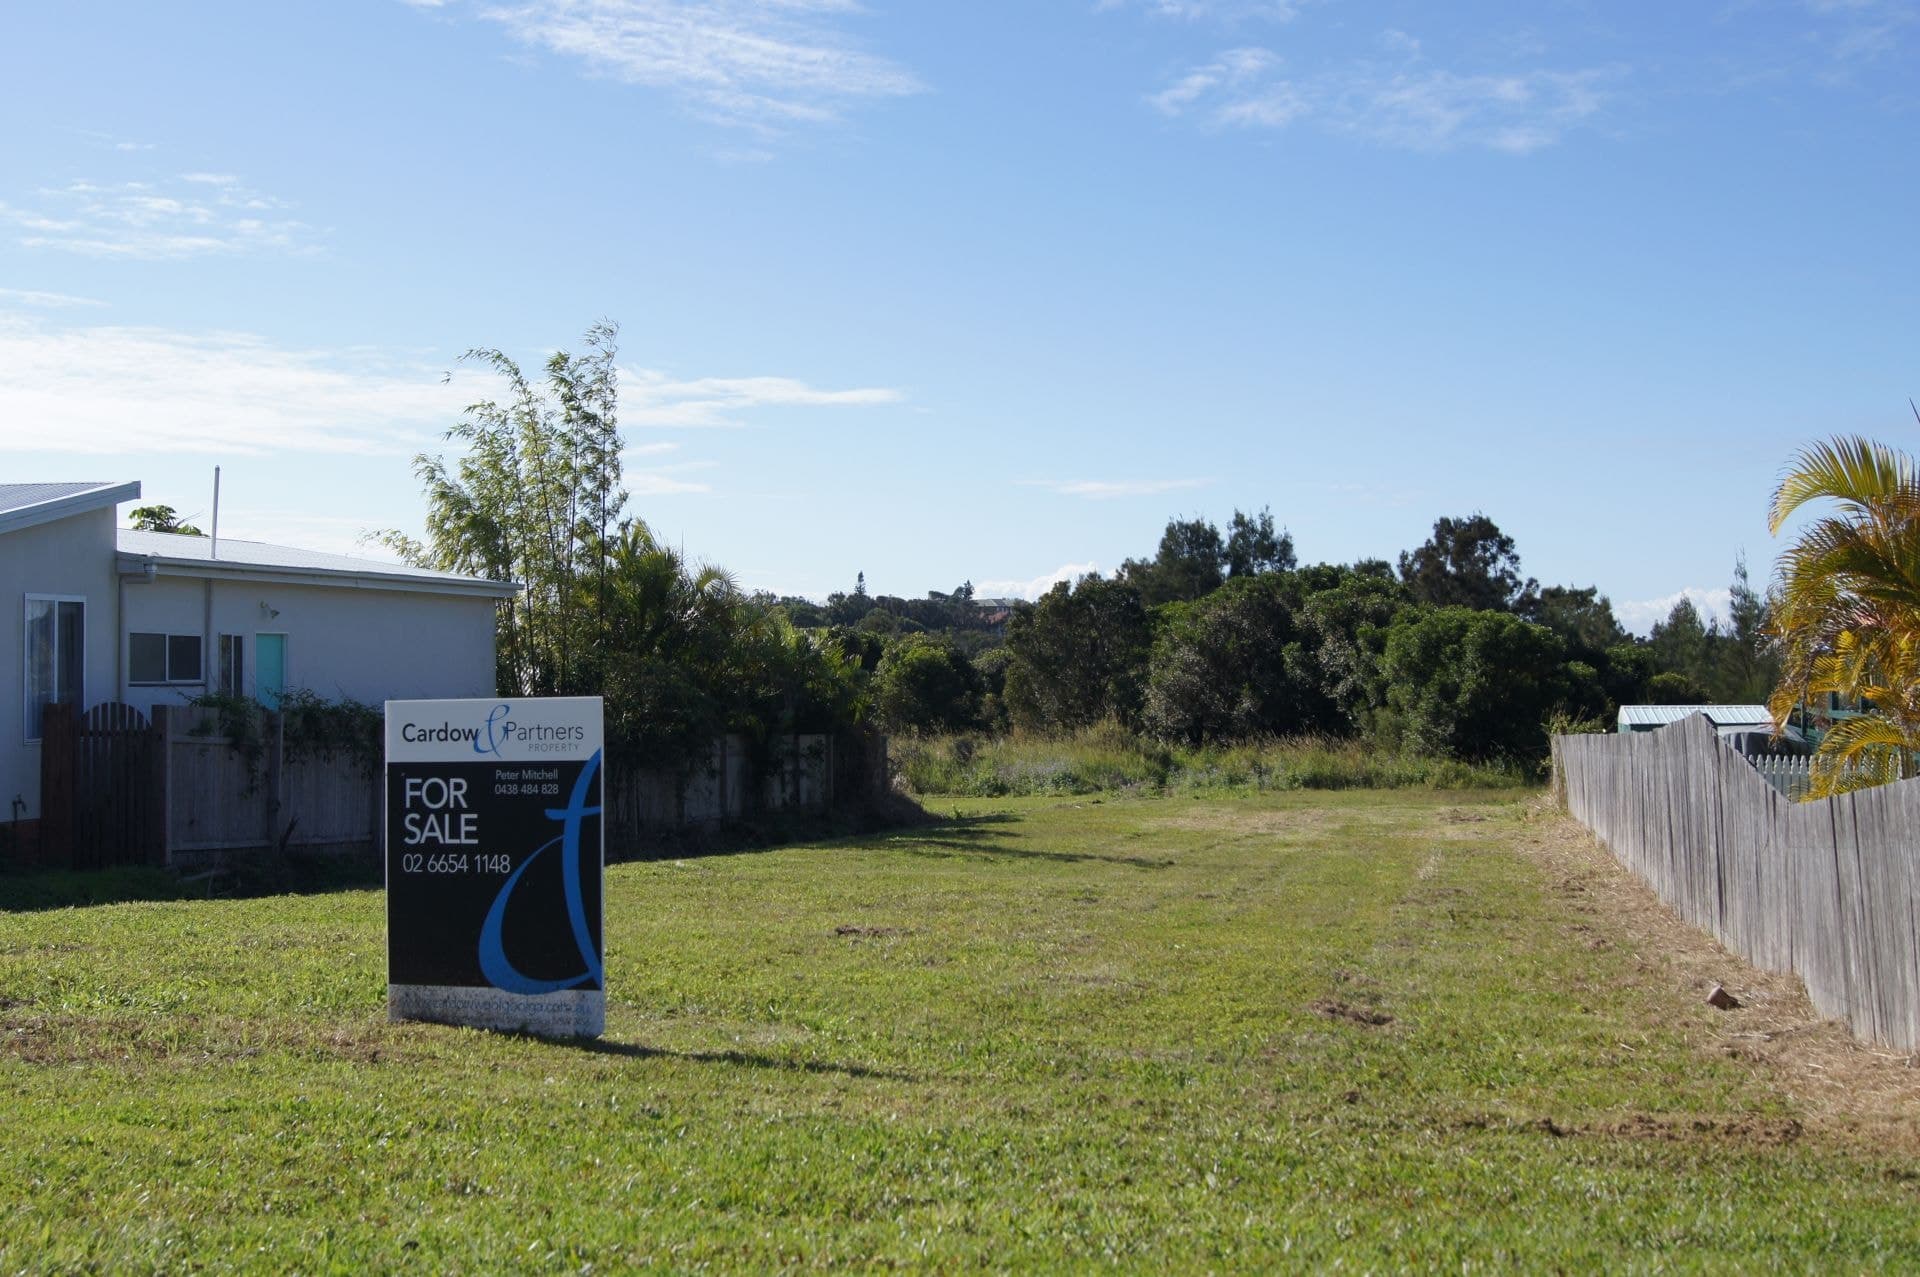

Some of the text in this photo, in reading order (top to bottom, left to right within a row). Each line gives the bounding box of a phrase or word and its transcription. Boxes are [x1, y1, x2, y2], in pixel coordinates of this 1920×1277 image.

[402, 721, 479, 743] Cardow
[504, 721, 584, 741] Partners
[528, 743, 579, 752] PROPERTY
[495, 768, 559, 780] Peter Mitchell
[405, 777, 468, 809] FOR
[494, 784, 559, 795] 0438 484 828
[404, 813, 479, 844] SALE
[402, 854, 511, 873] 02 6654 1148
